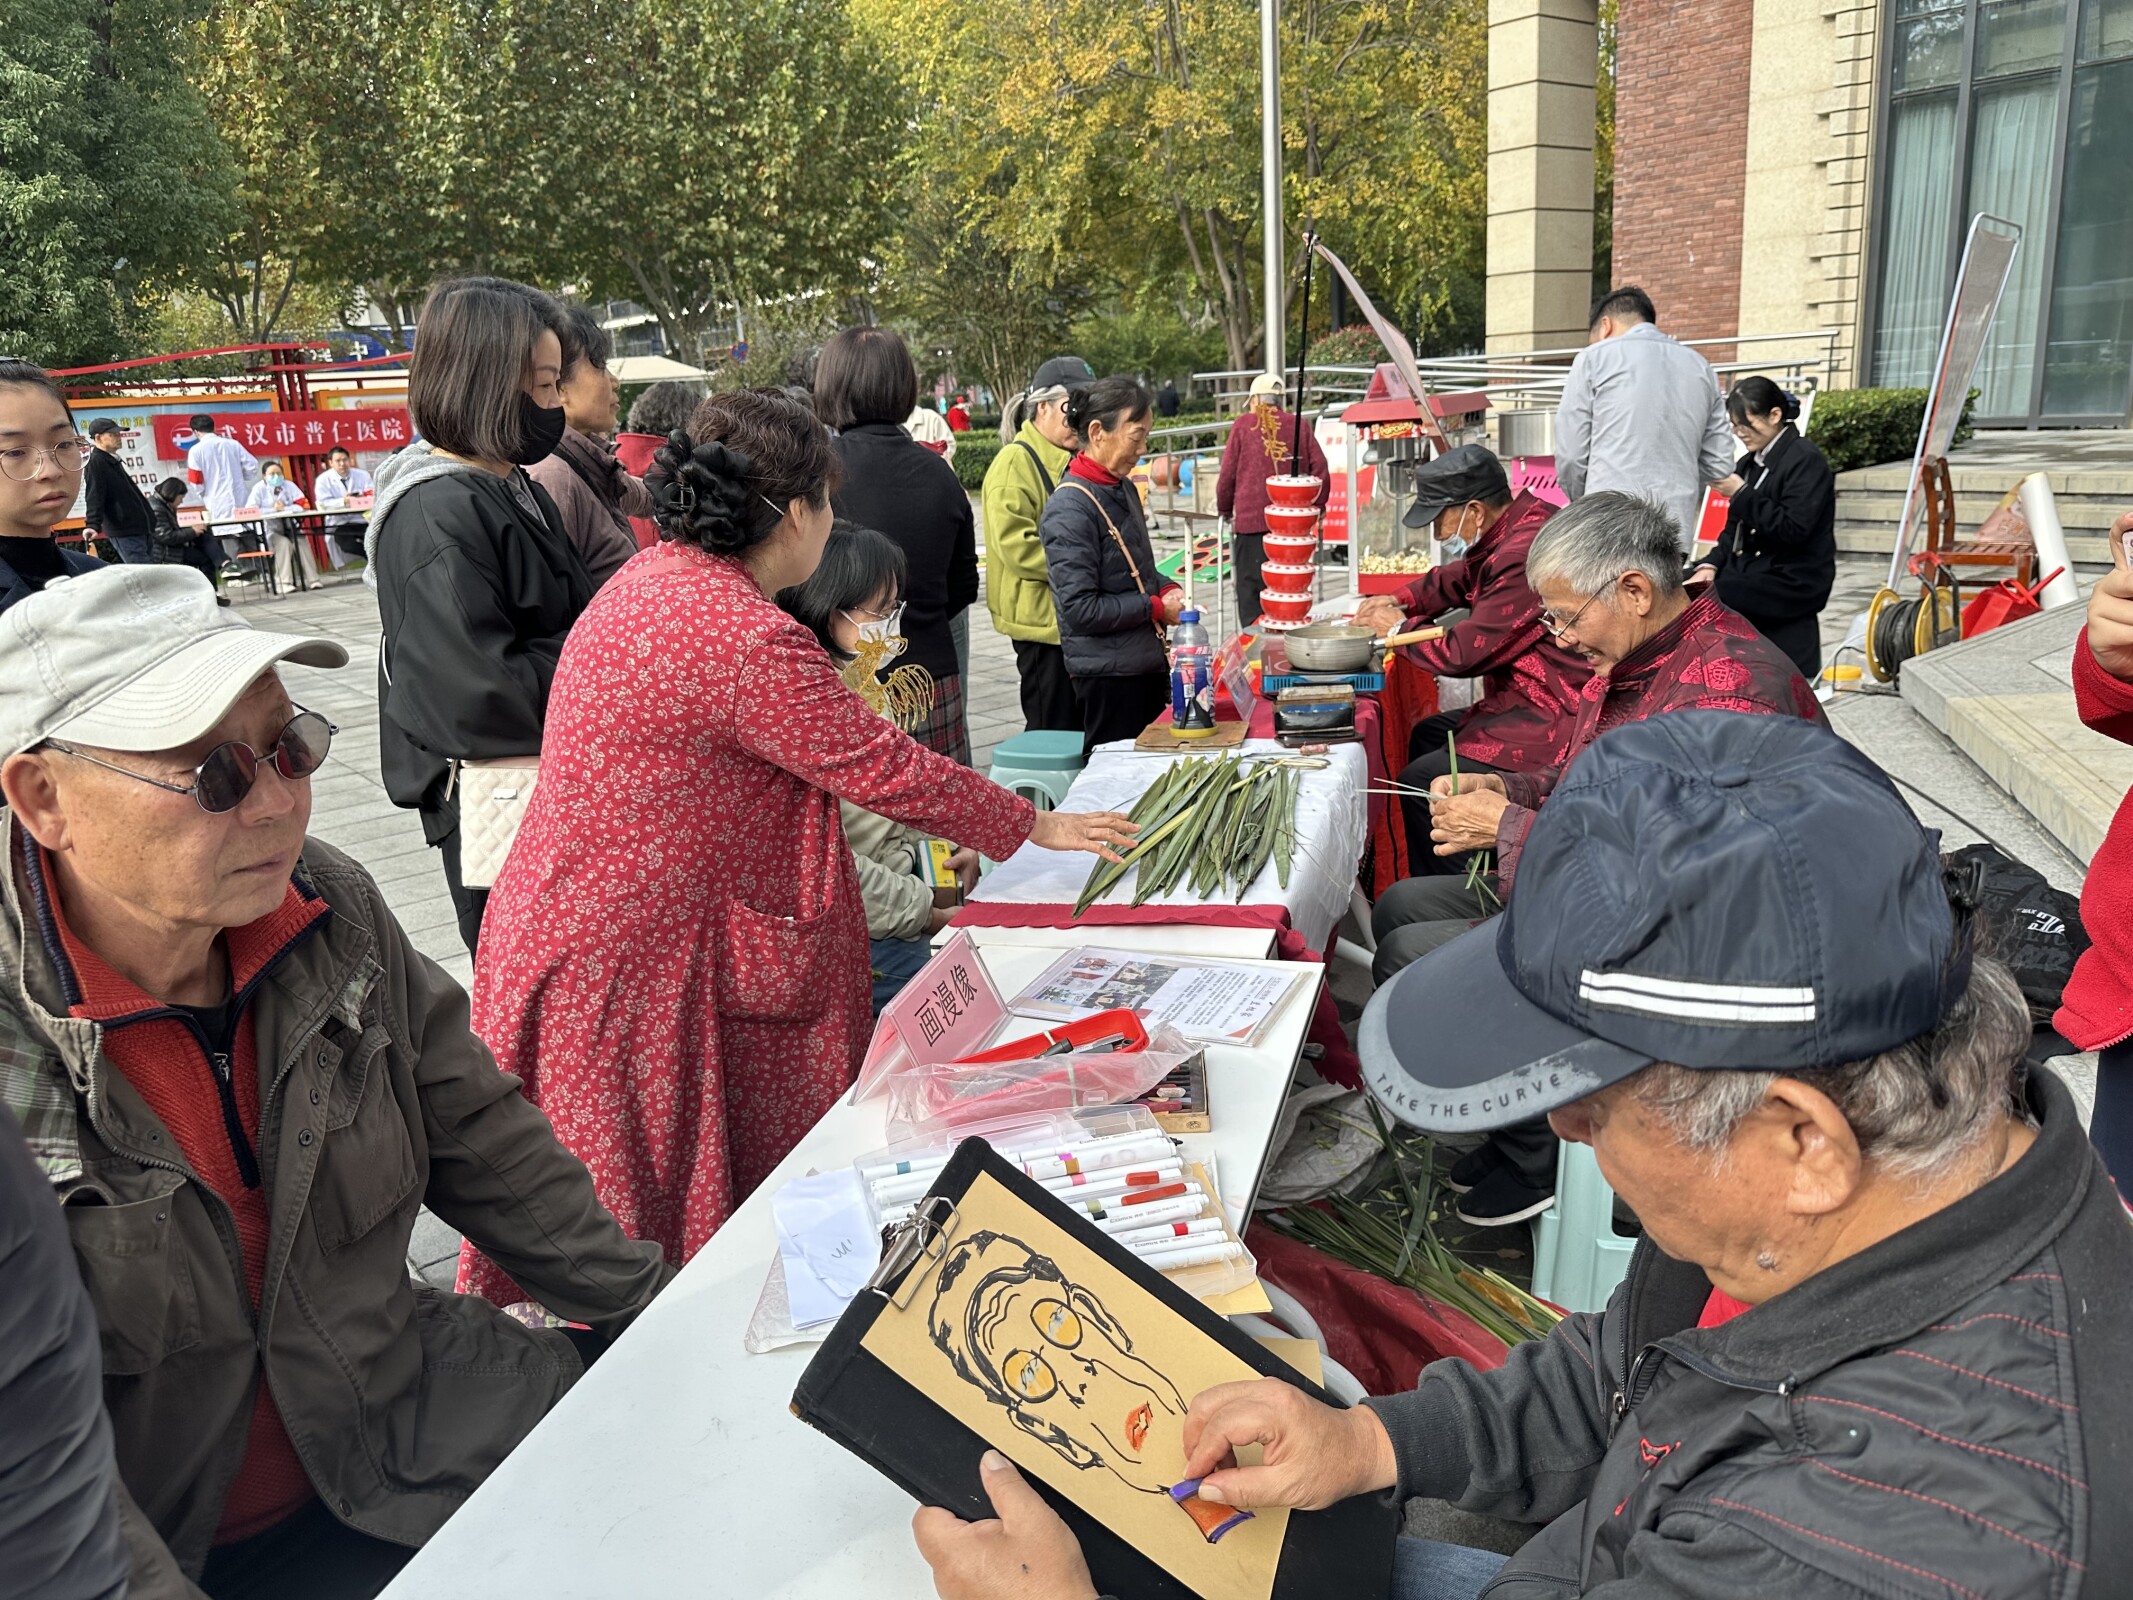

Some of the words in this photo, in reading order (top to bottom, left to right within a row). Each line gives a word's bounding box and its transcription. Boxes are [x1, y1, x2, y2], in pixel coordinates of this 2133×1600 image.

[914, 964, 977, 1047] 画漫像
[1377, 1073, 1418, 1111] TAKE
[1430, 1103, 1469, 1117] THE
[1482, 1073, 1561, 1112] CURVE
